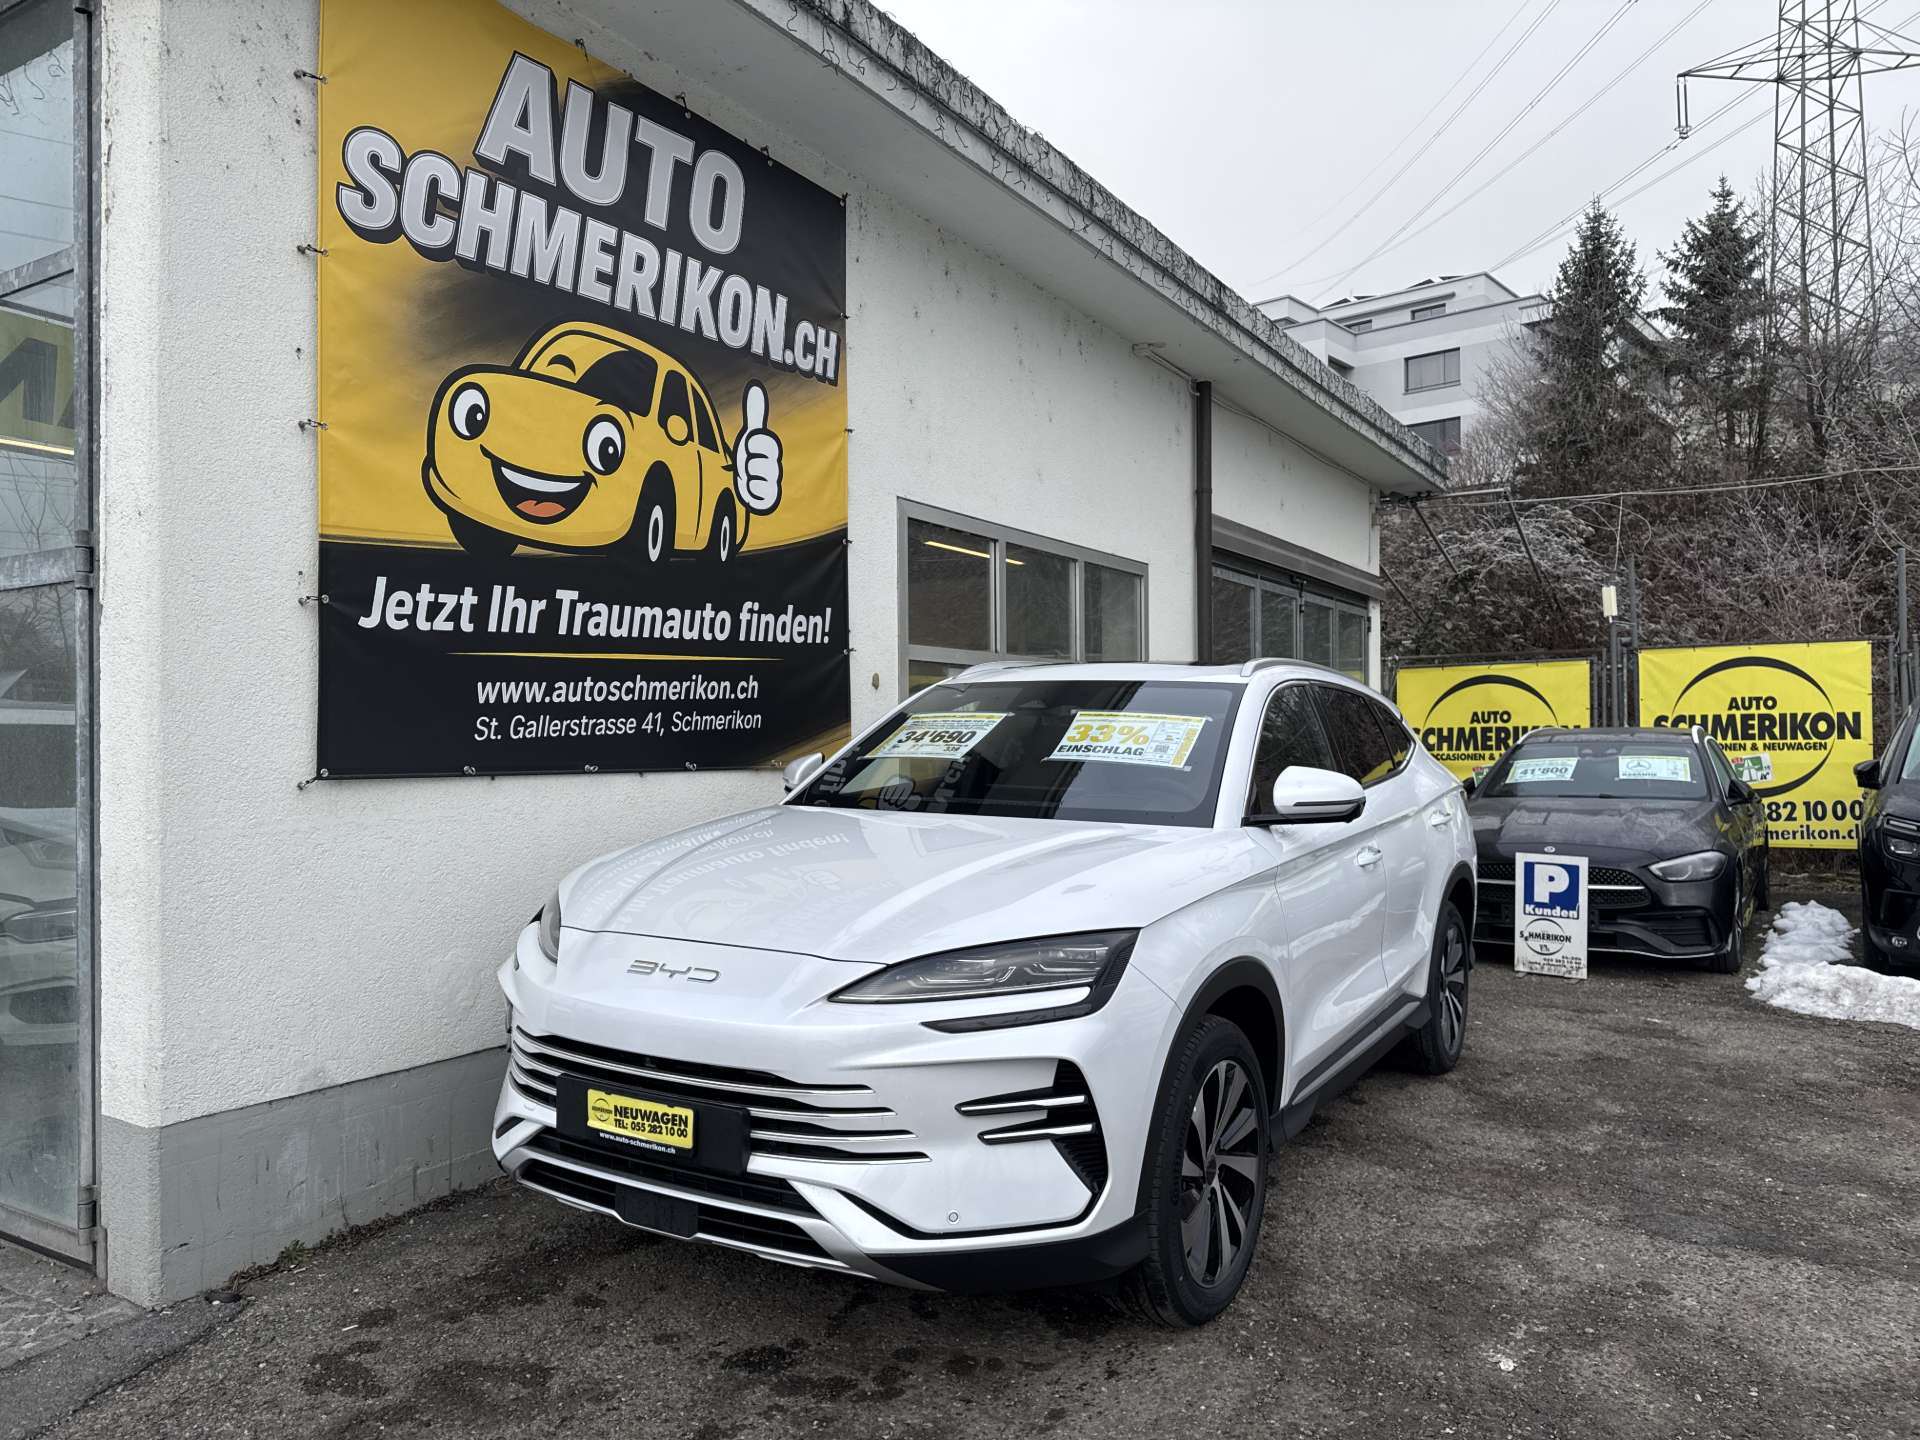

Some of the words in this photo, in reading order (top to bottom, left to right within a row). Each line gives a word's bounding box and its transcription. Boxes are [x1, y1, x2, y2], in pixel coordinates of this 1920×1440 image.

[473, 51, 745, 254] AUTO
[337, 127, 838, 381] SCHMERIKON.CH
[357, 576, 478, 633] Jetzt
[487, 585, 546, 635] Ihr
[555, 590, 729, 641] Traumauto
[740, 602, 831, 644] finden!
[476, 674, 759, 704] www.autoschmerikon.ch
[1728, 696, 1777, 711] AUTO
[473, 716, 503, 741] St.
[509, 711, 637, 739] Gallerstrasse
[642, 712, 665, 737] 41,
[671, 711, 762, 733] Schmerikon
[1470, 710, 1512, 724] AUTO
[897, 730, 976, 744] 34'690
[1066, 724, 1149, 745] 33%
[1412, 724, 1581, 752] CHMERI
[1057, 744, 1145, 756] EINSCHLAG
[1750, 742, 1759, 751] &
[1763, 741, 1828, 751] NEUWAGEN
[1761, 800, 1798, 822] 82
[1803, 800, 1828, 821] 10
[1534, 863, 1569, 903] P
[1525, 904, 1578, 919] Kunden
[627, 959, 722, 983] BYD
[614, 1105, 688, 1128] NEUWAGEN
[614, 1119, 628, 1130] TEL:
[631, 1122, 645, 1133] 055
[648, 1124, 663, 1135] 282
[665, 1126, 675, 1136] 10
[677, 1127, 688, 1138] 00
[599, 1132, 676, 1154] www.auto-schmerikon.ch
